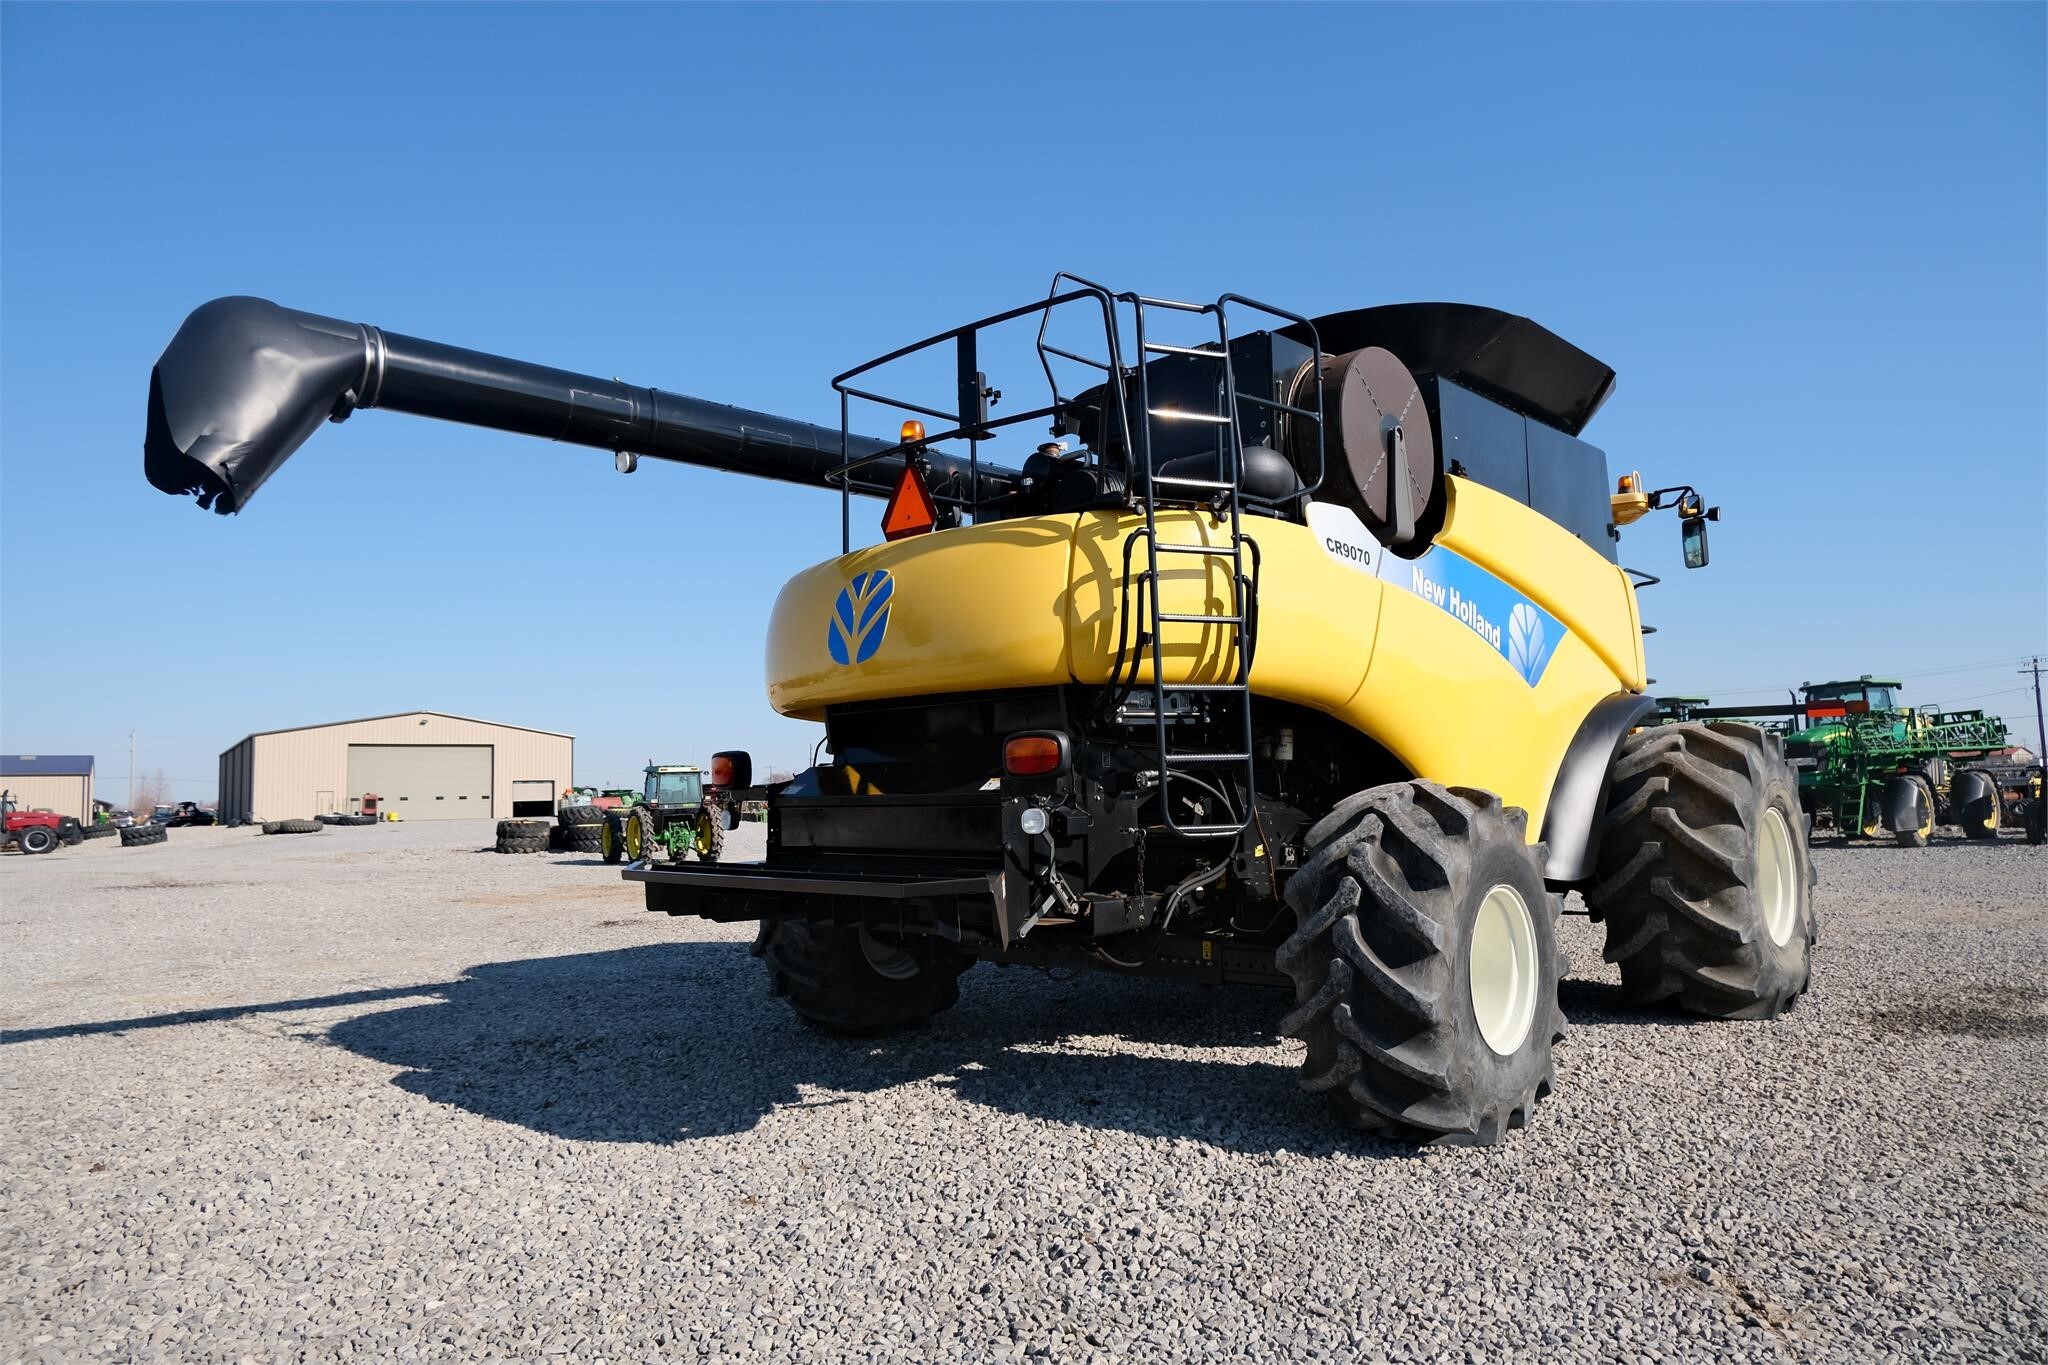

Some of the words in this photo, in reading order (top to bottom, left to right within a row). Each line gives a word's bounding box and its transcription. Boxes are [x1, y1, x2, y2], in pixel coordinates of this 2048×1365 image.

[1326, 537, 1371, 566] CR9070
[1412, 564, 1446, 607] New
[1449, 586, 1501, 651] Holland
